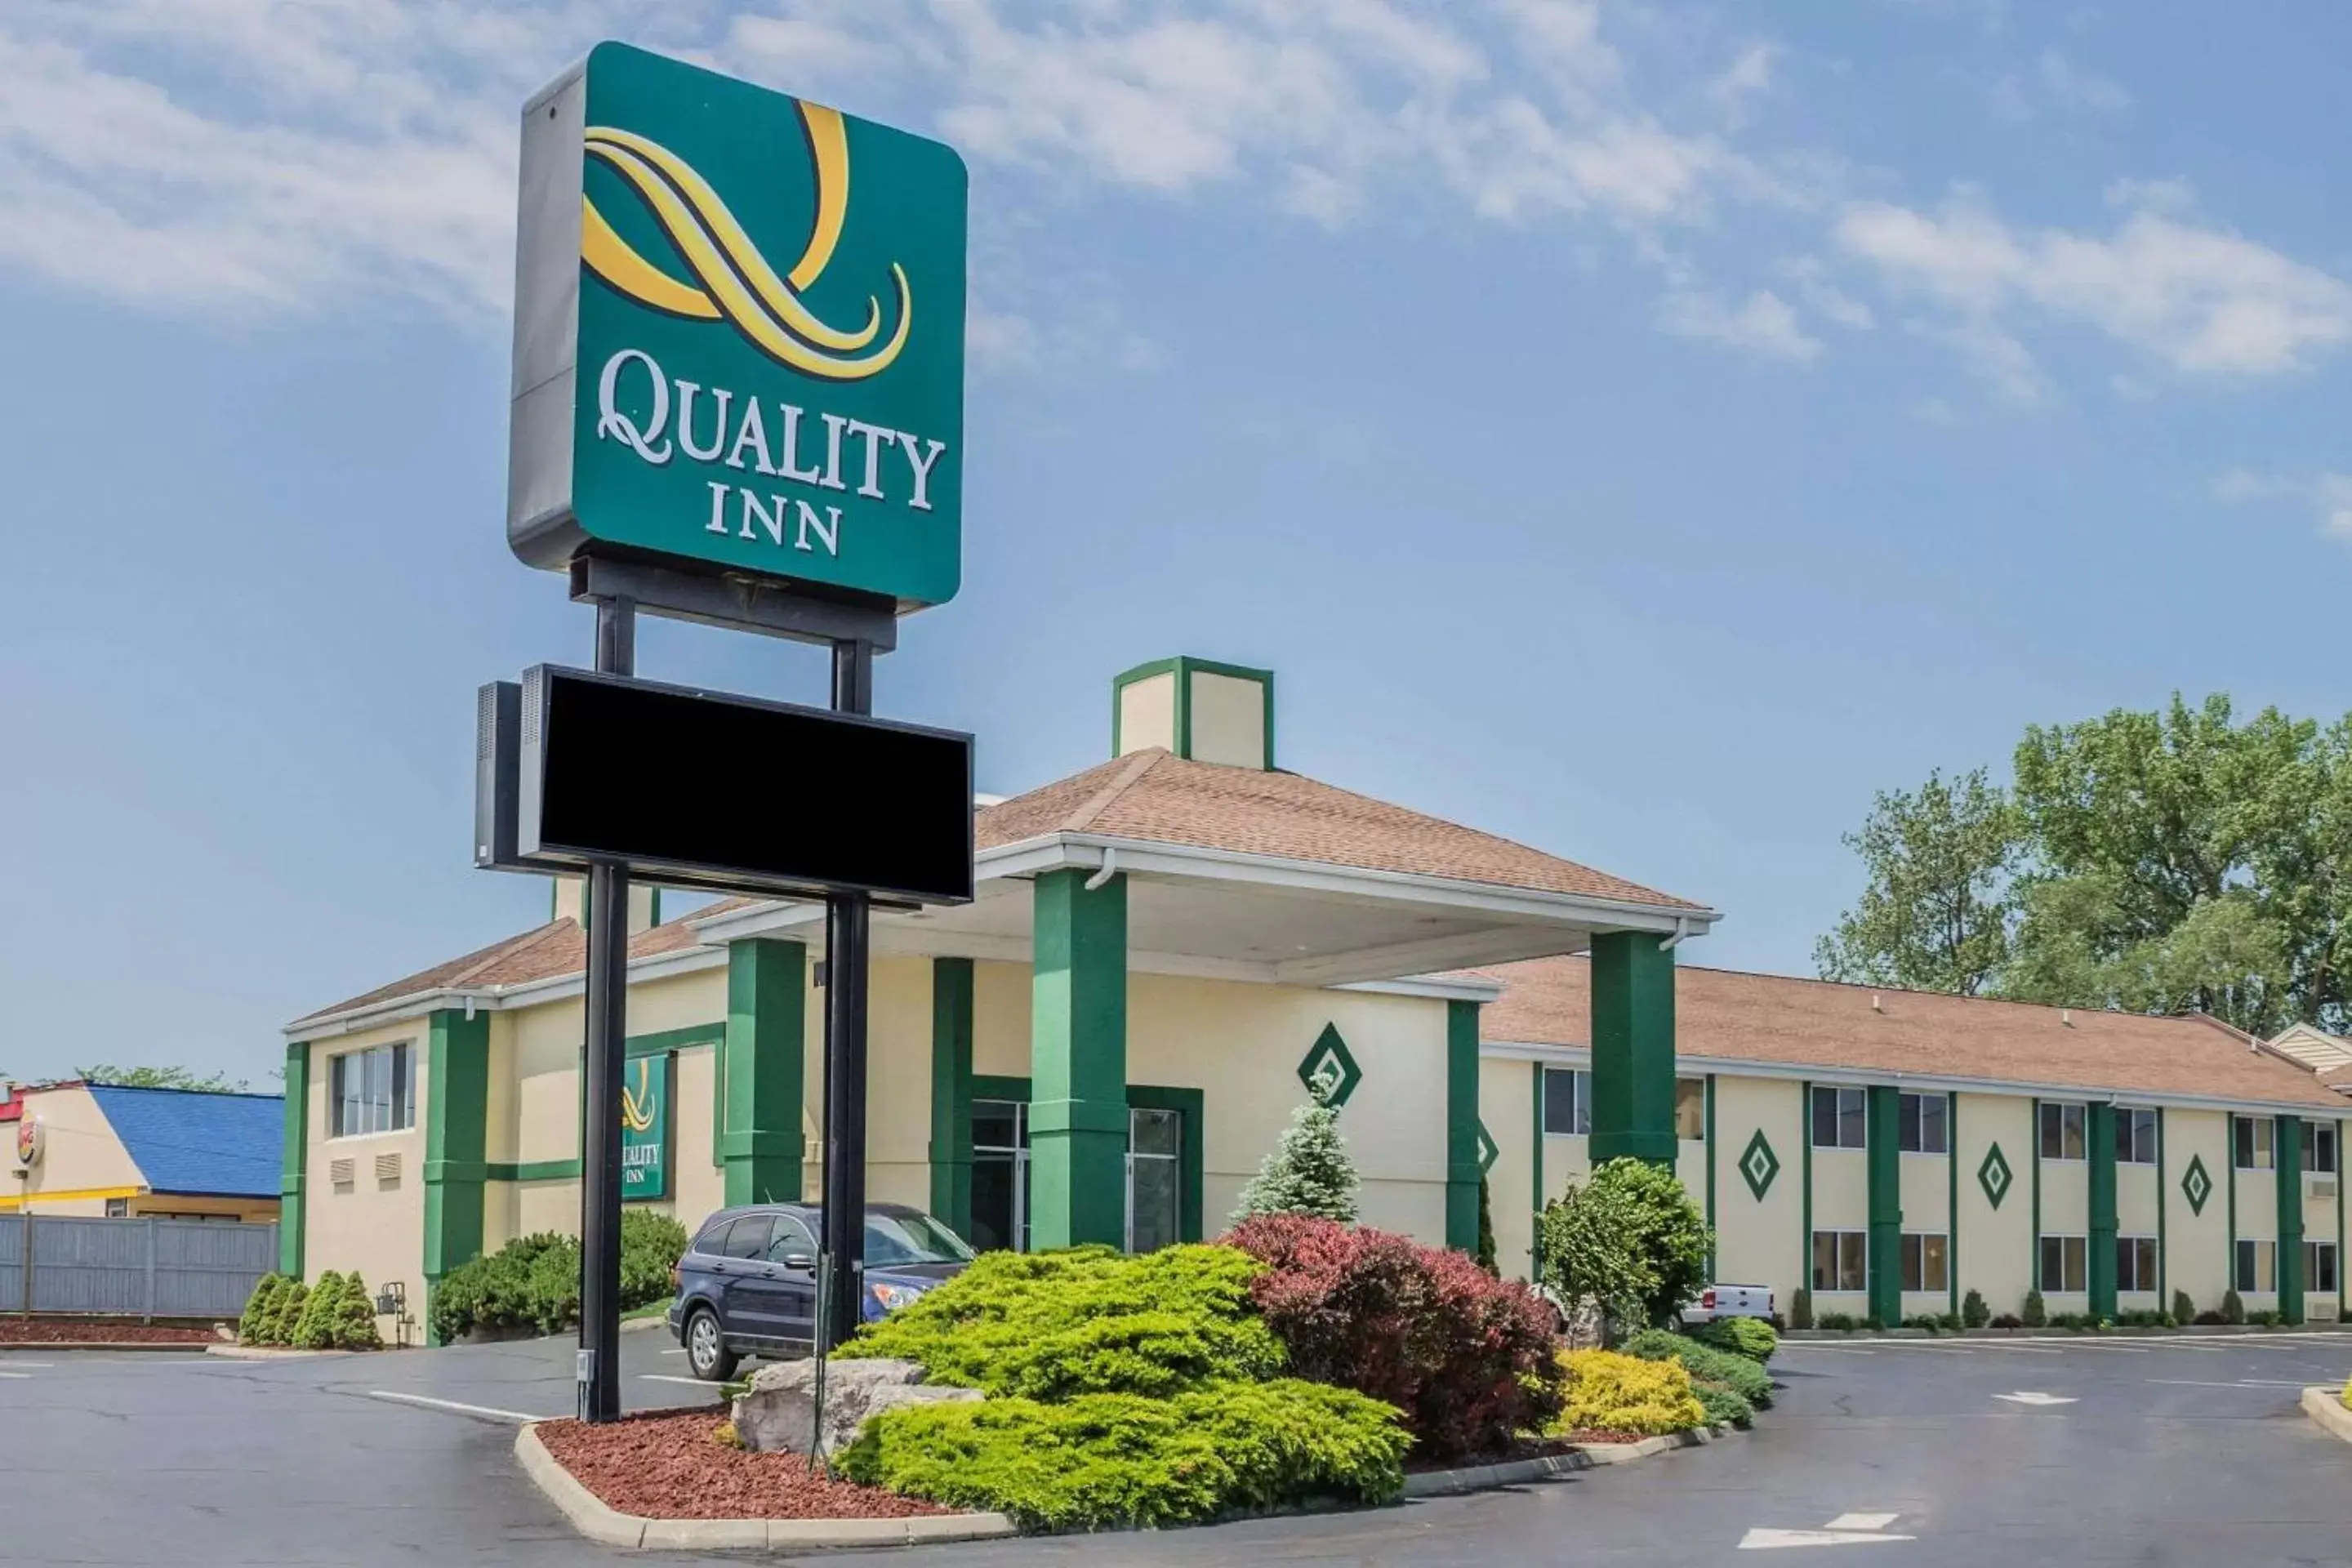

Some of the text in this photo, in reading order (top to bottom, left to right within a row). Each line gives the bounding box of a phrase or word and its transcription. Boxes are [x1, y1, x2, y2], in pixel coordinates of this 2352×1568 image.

[598, 349, 946, 510] QUALITY
[706, 481, 842, 556] INN
[622, 1143, 660, 1166] UALITY
[626, 1169, 644, 1183] INN
